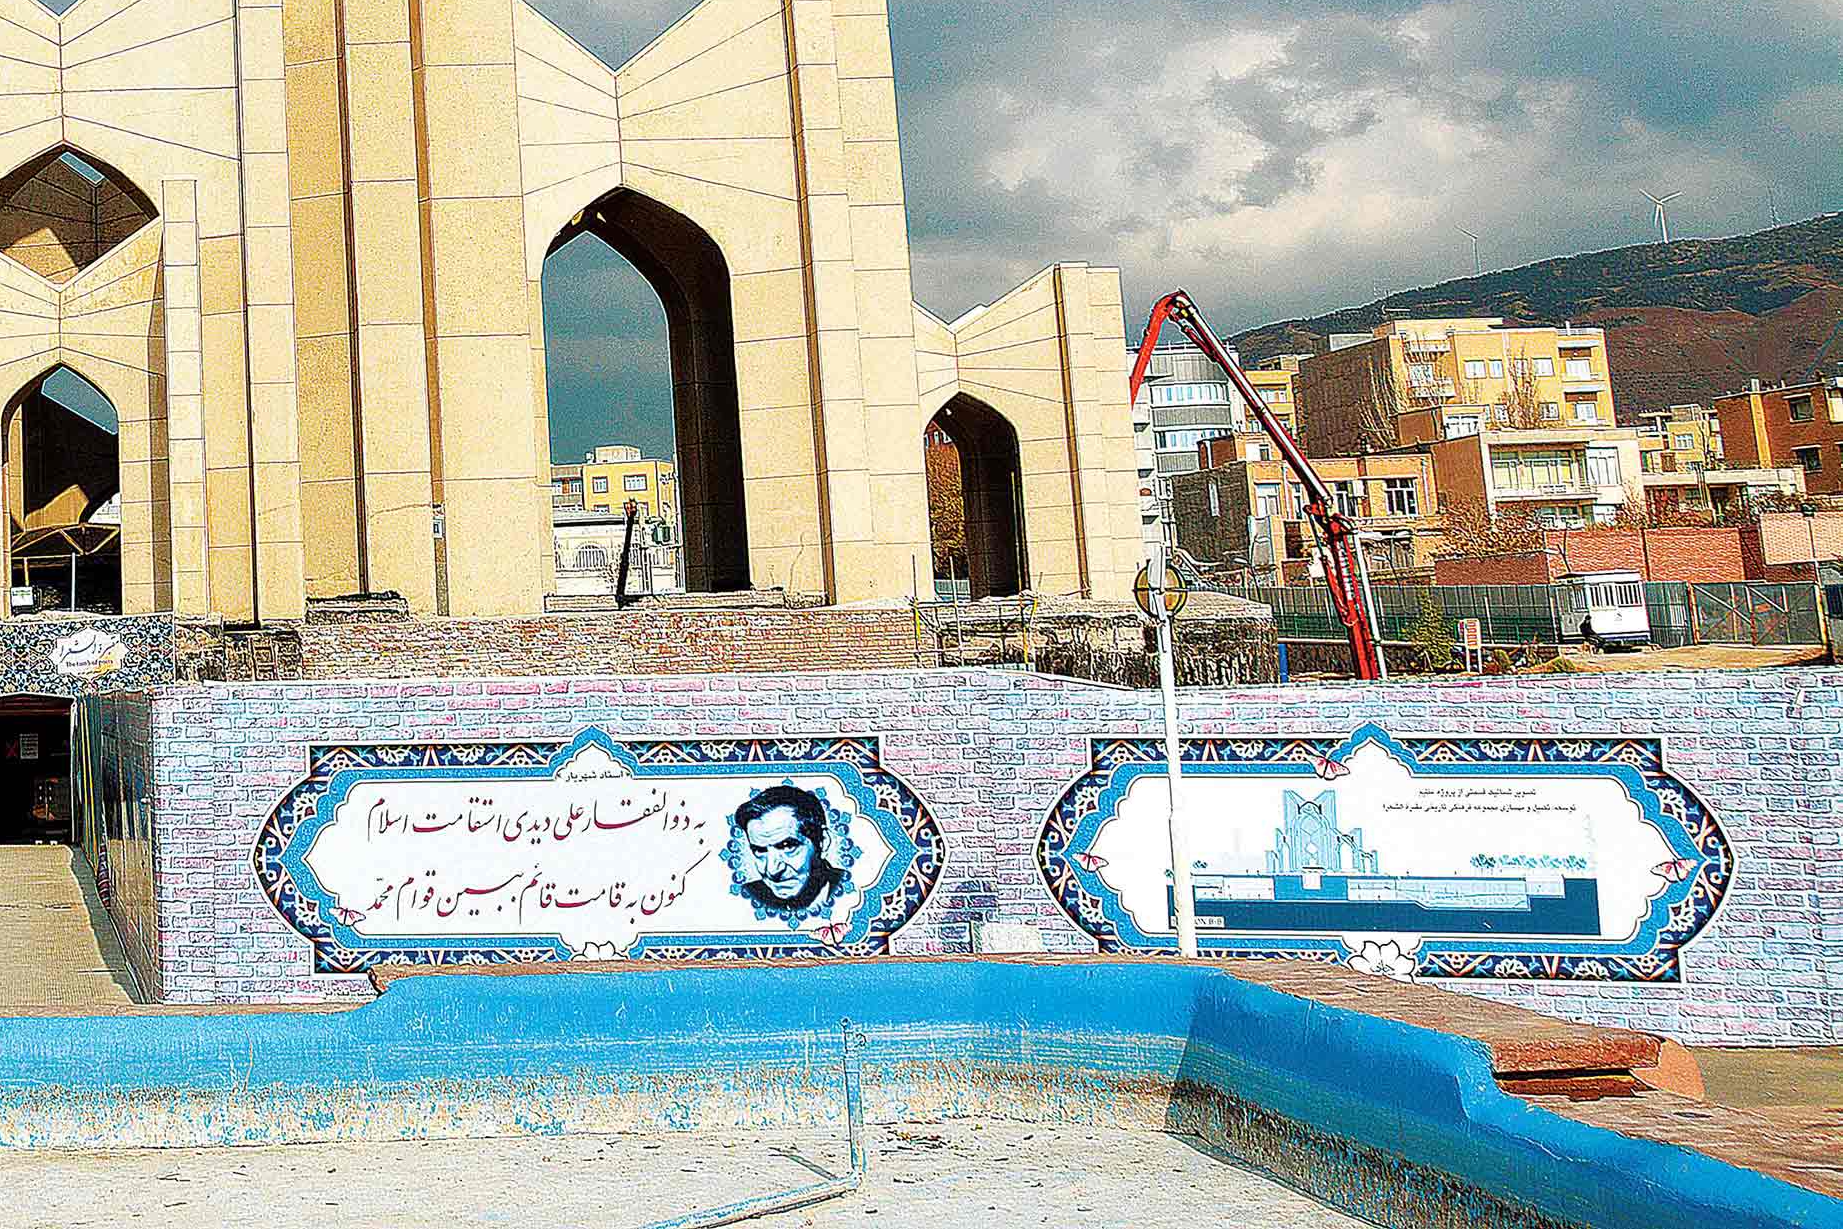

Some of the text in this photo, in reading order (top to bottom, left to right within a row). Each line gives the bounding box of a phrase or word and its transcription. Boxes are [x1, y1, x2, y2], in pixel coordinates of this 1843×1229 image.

[565, 770, 597, 783] شهریار
[367, 788, 707, 845] به ذوالفقار علی دیدی استقامت اسلام
[396, 869, 436, 921] قوام
[437, 872, 525, 917] ببین
[554, 882, 627, 909] قامت
[640, 850, 712, 915] کنون
[624, 899, 638, 925] به
